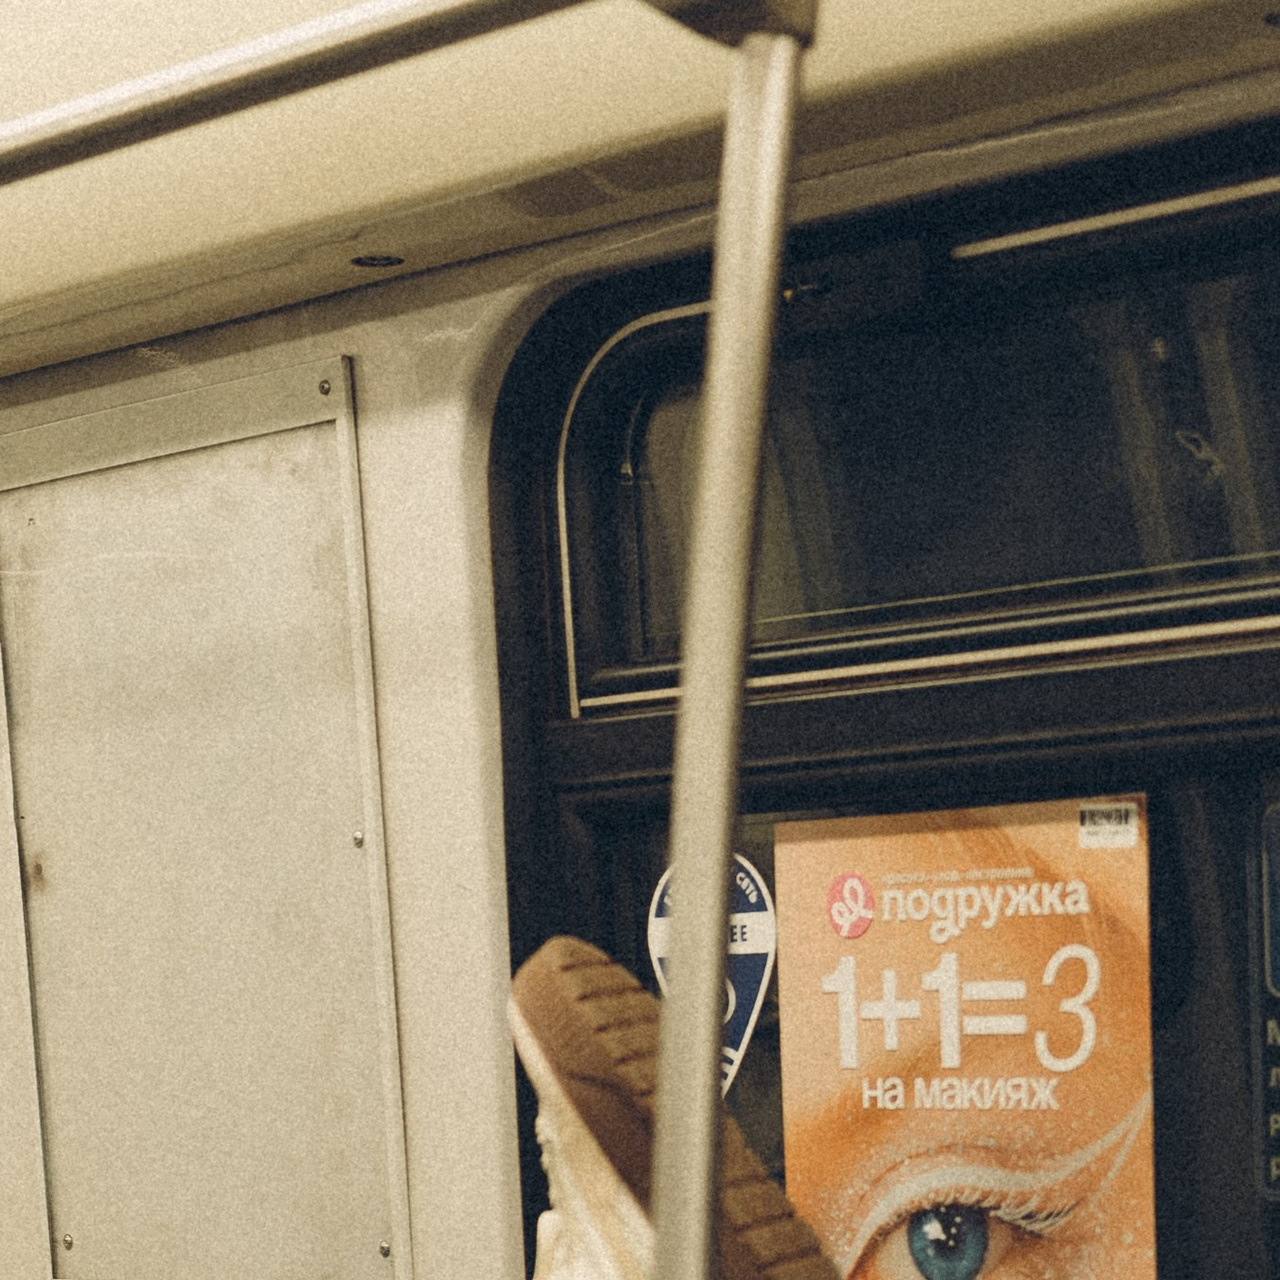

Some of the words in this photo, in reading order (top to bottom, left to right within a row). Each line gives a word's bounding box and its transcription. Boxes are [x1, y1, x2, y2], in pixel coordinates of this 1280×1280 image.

[881, 879, 1091, 944] подружка
[861, 1076, 905, 1110] на
[913, 1076, 1060, 1111] макияж
